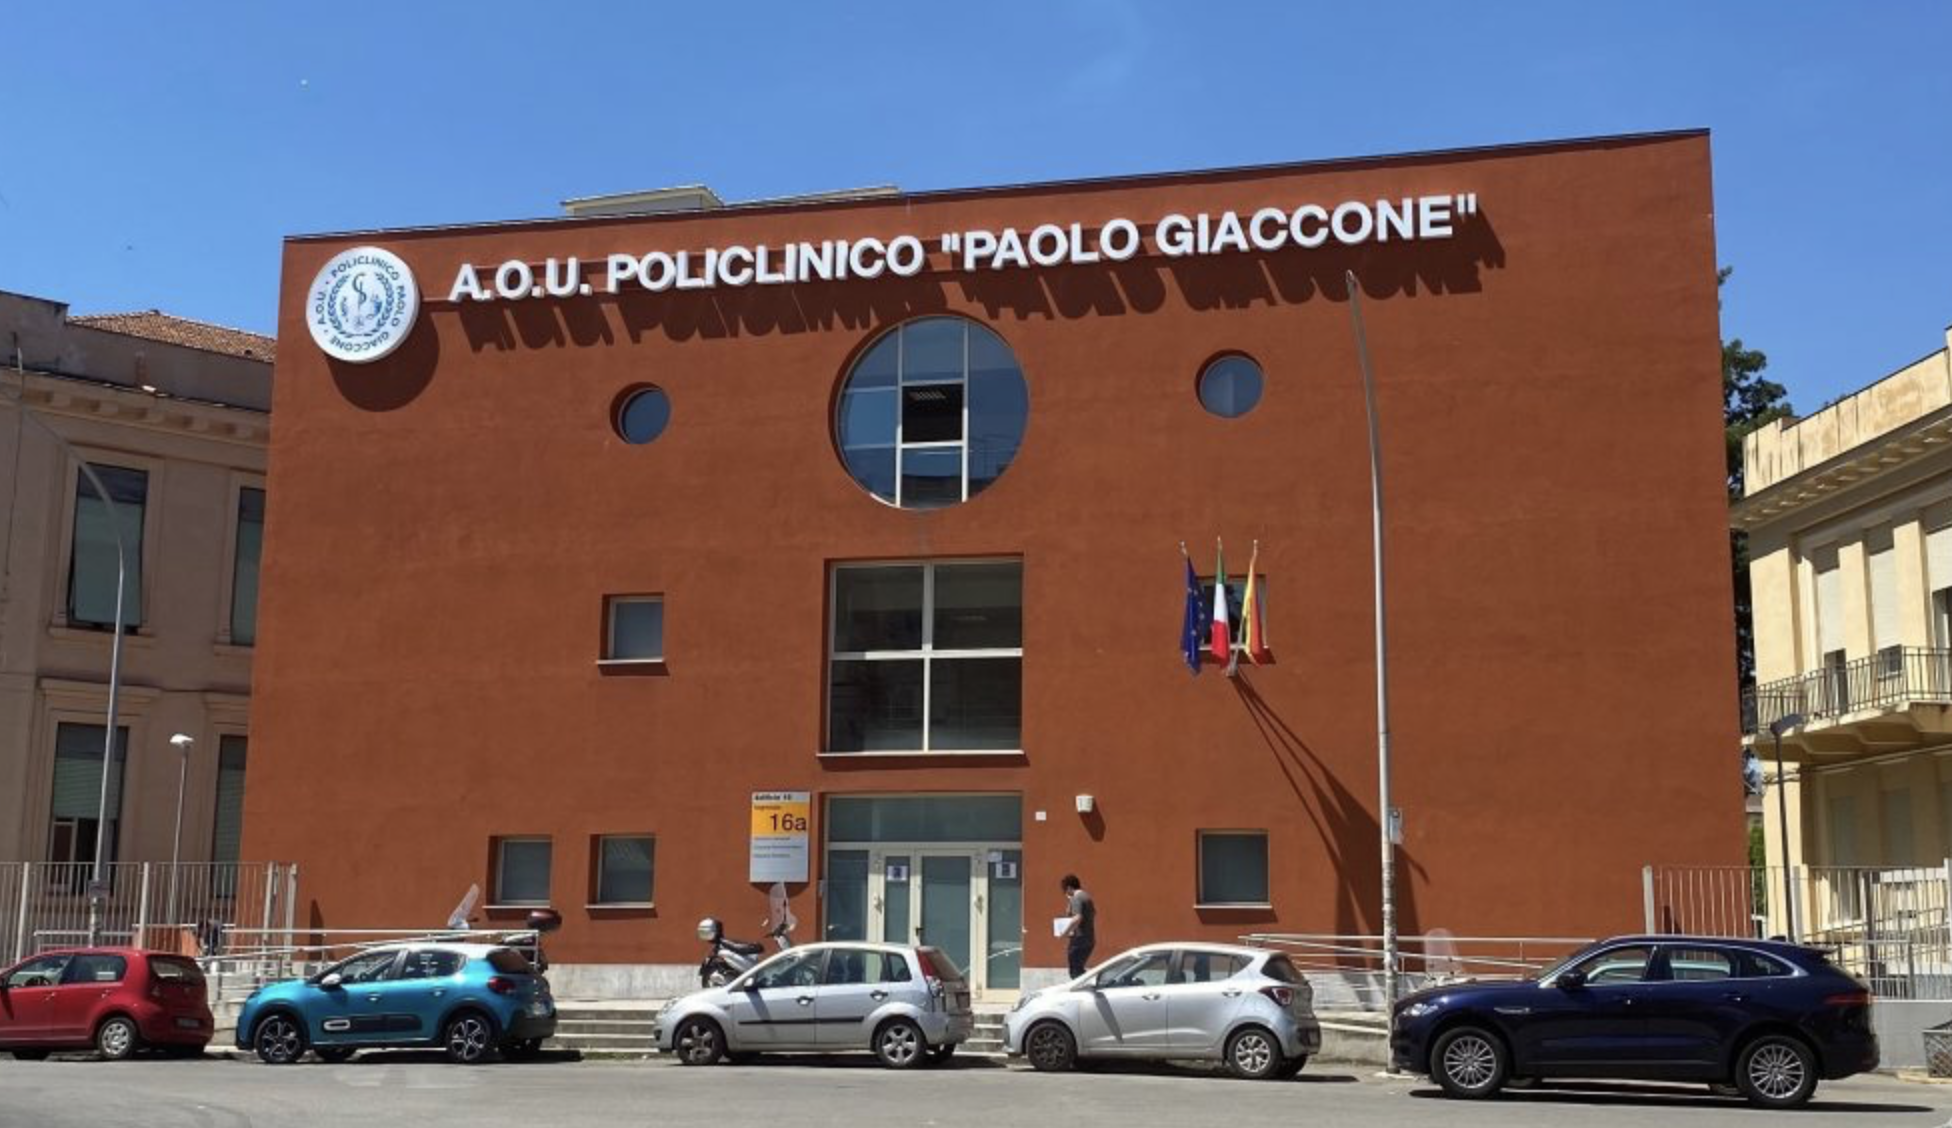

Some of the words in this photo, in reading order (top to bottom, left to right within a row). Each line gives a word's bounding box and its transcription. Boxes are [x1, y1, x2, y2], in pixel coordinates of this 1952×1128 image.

[448, 257, 592, 301] A.O.U.
[606, 235, 924, 293] POLICLINICO
[941, 219, 1140, 271] "PAOLO
[1155, 192, 1477, 255] GIACCONE"
[331, 255, 400, 281] POLICLINICO
[770, 813, 807, 831] 16a
